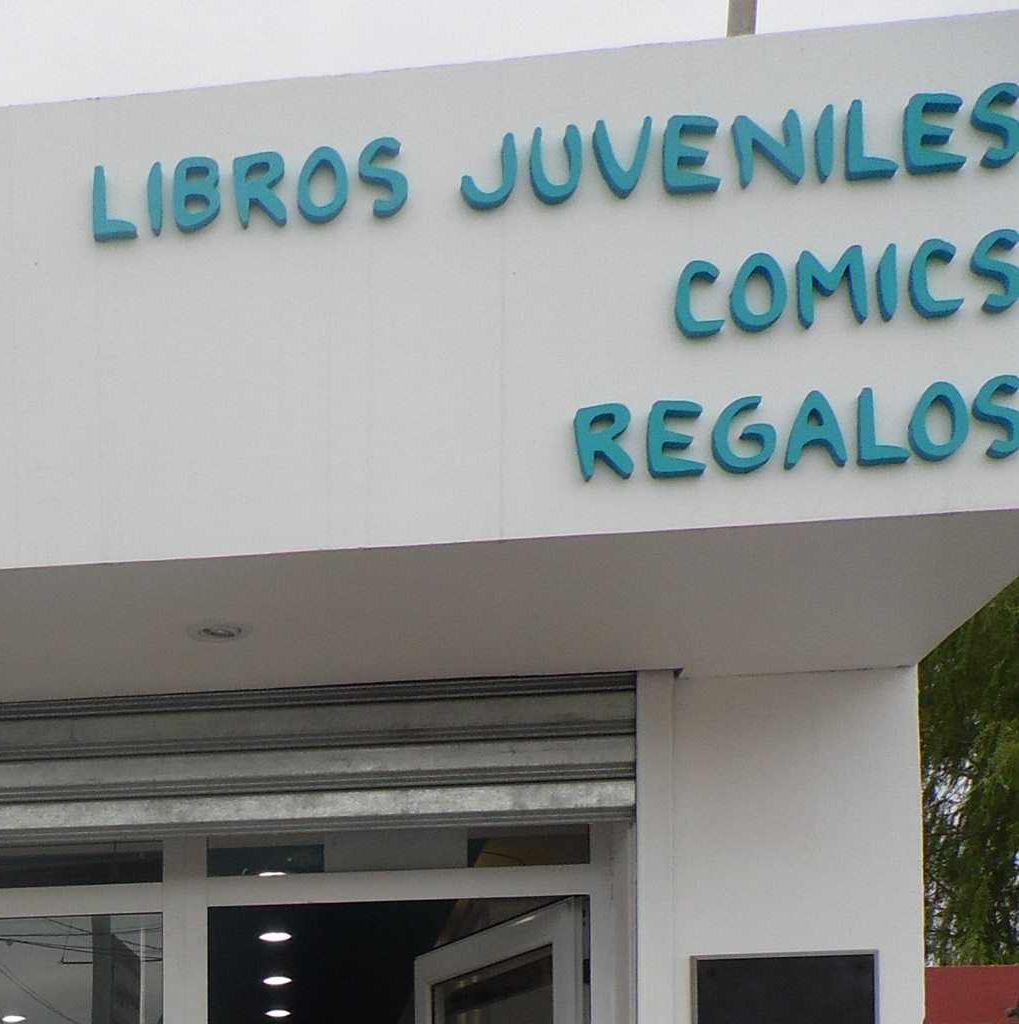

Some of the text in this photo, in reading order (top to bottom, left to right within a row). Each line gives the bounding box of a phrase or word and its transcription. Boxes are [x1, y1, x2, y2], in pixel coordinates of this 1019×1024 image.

[93, 83, 1019, 241] LIBROS JUVENILES
[674, 229, 1019, 338] COMICS
[573, 374, 1019, 481] REGALOS
